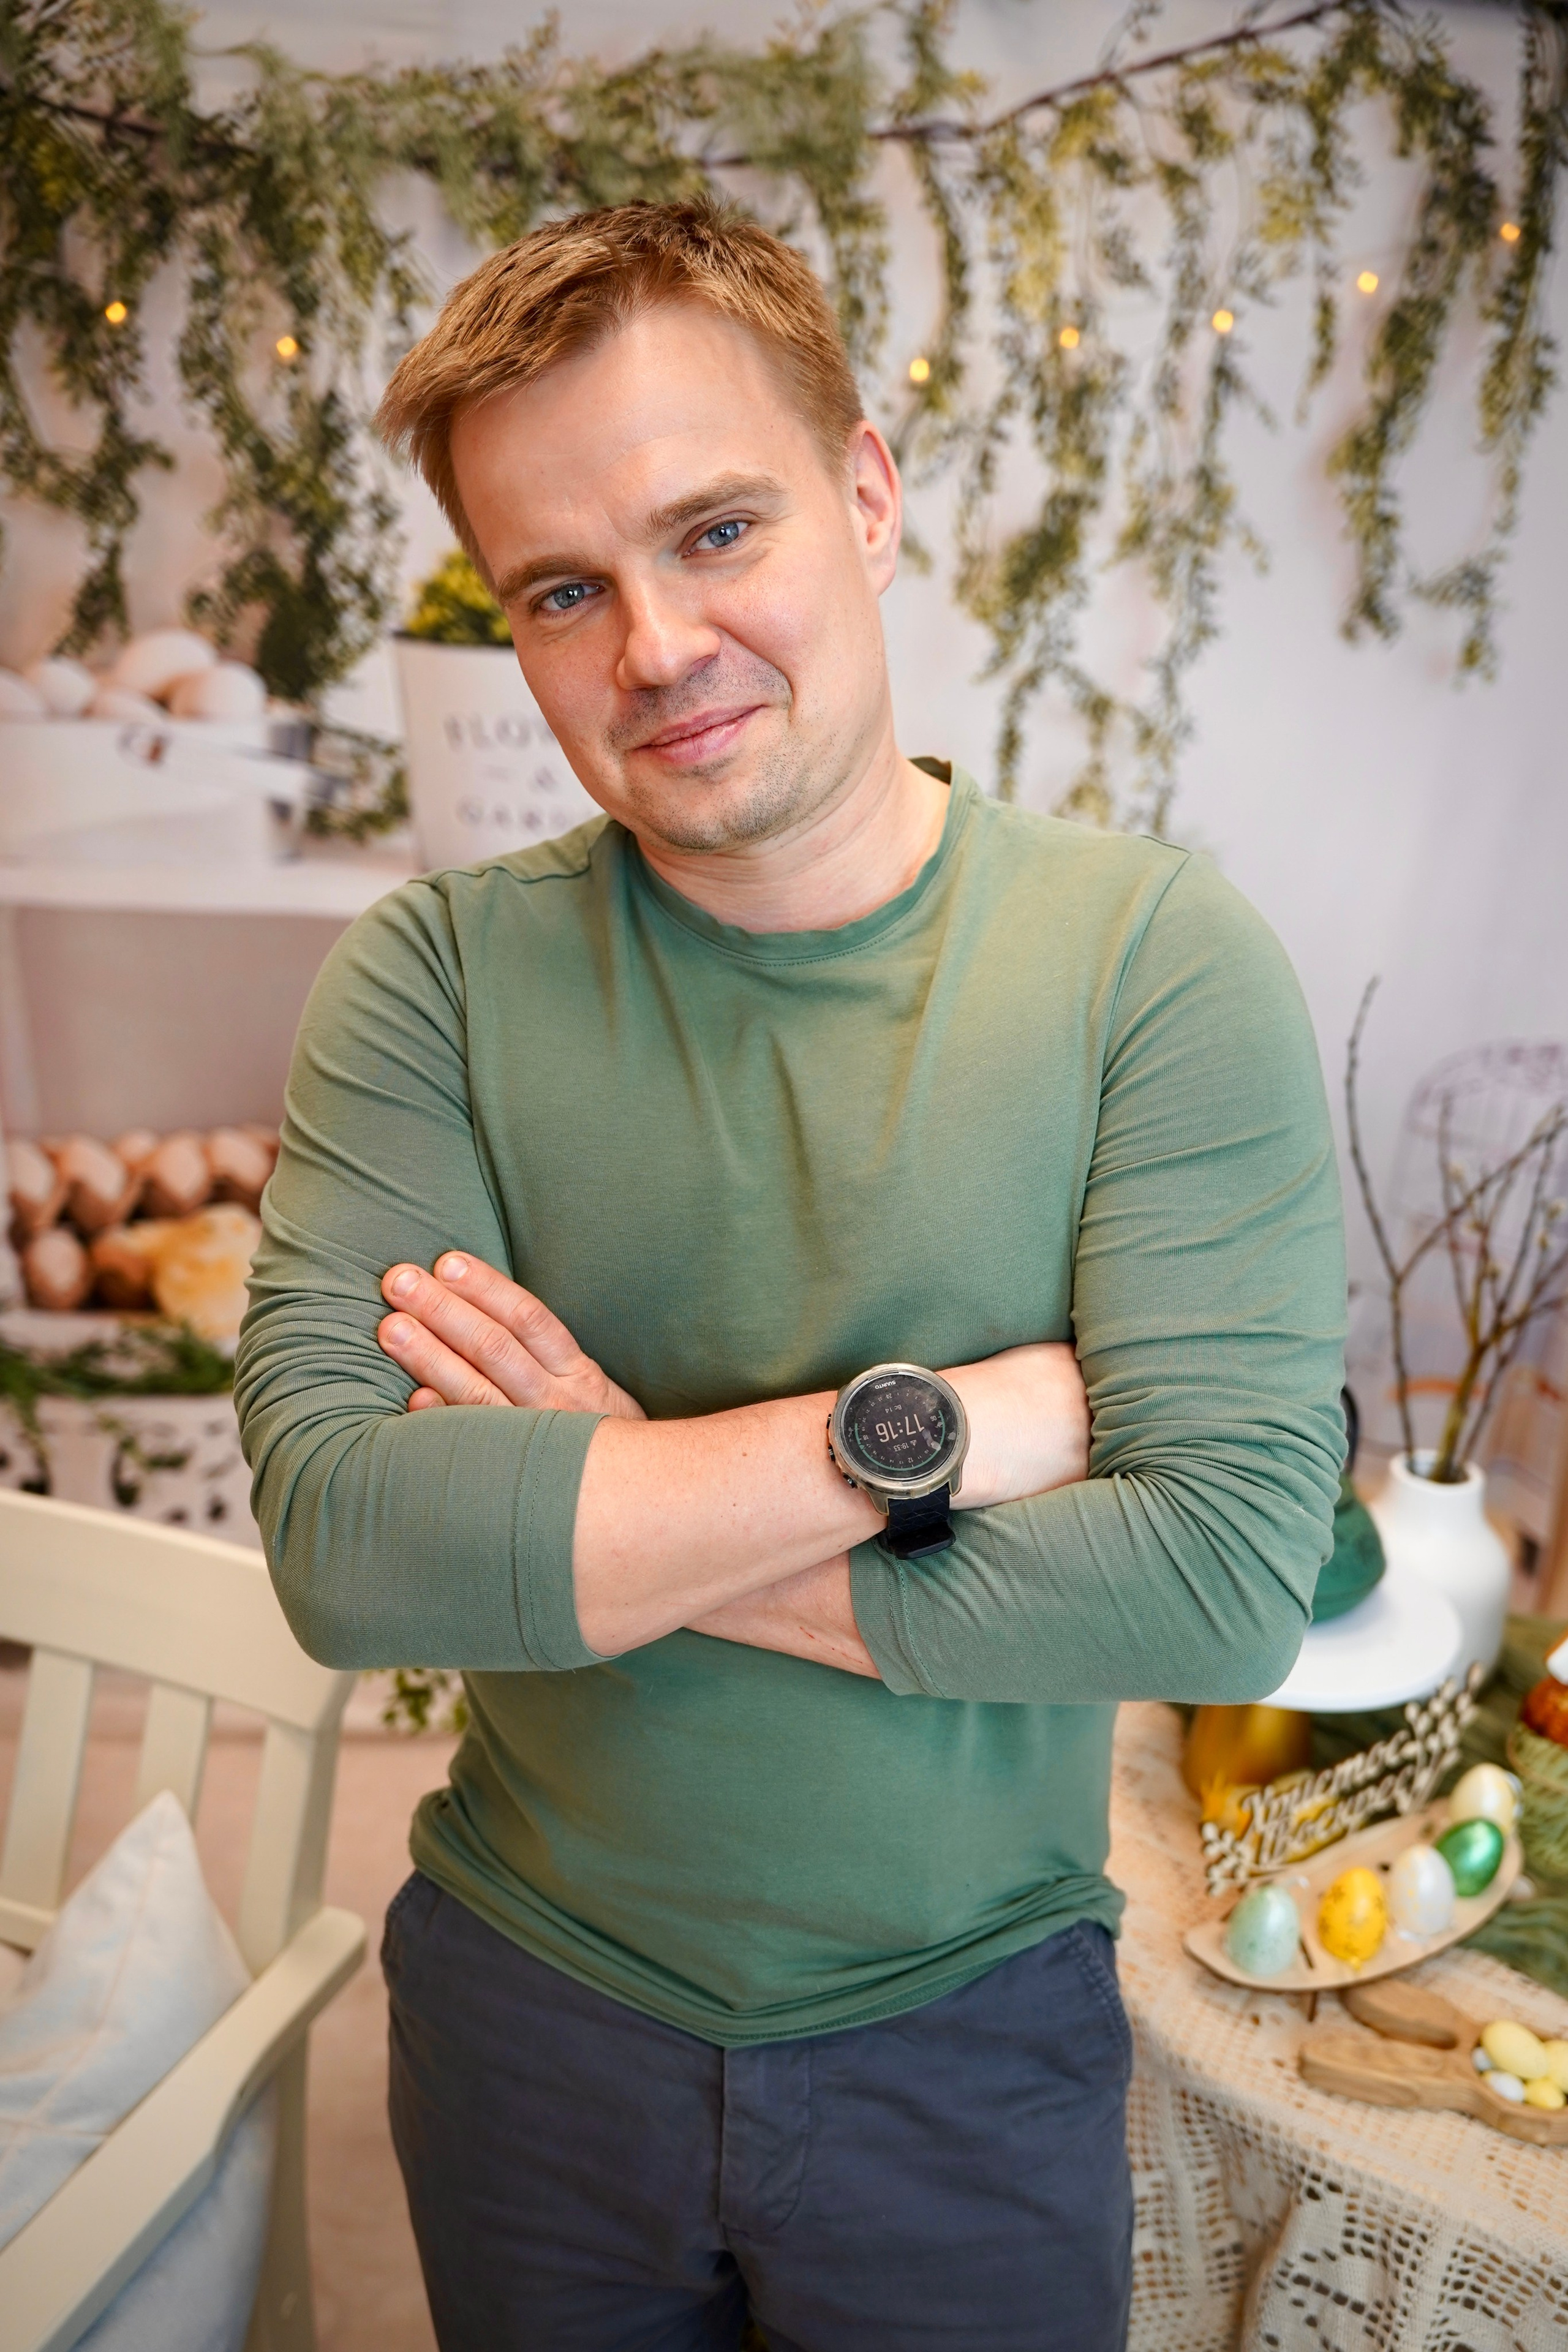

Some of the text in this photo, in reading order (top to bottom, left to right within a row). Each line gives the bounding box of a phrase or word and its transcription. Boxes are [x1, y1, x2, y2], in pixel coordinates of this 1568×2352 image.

[875, 1380, 896, 1389] SUUNTO
[875, 1414, 925, 1442] 17:16
[893, 1442, 910, 1452] 19:33
